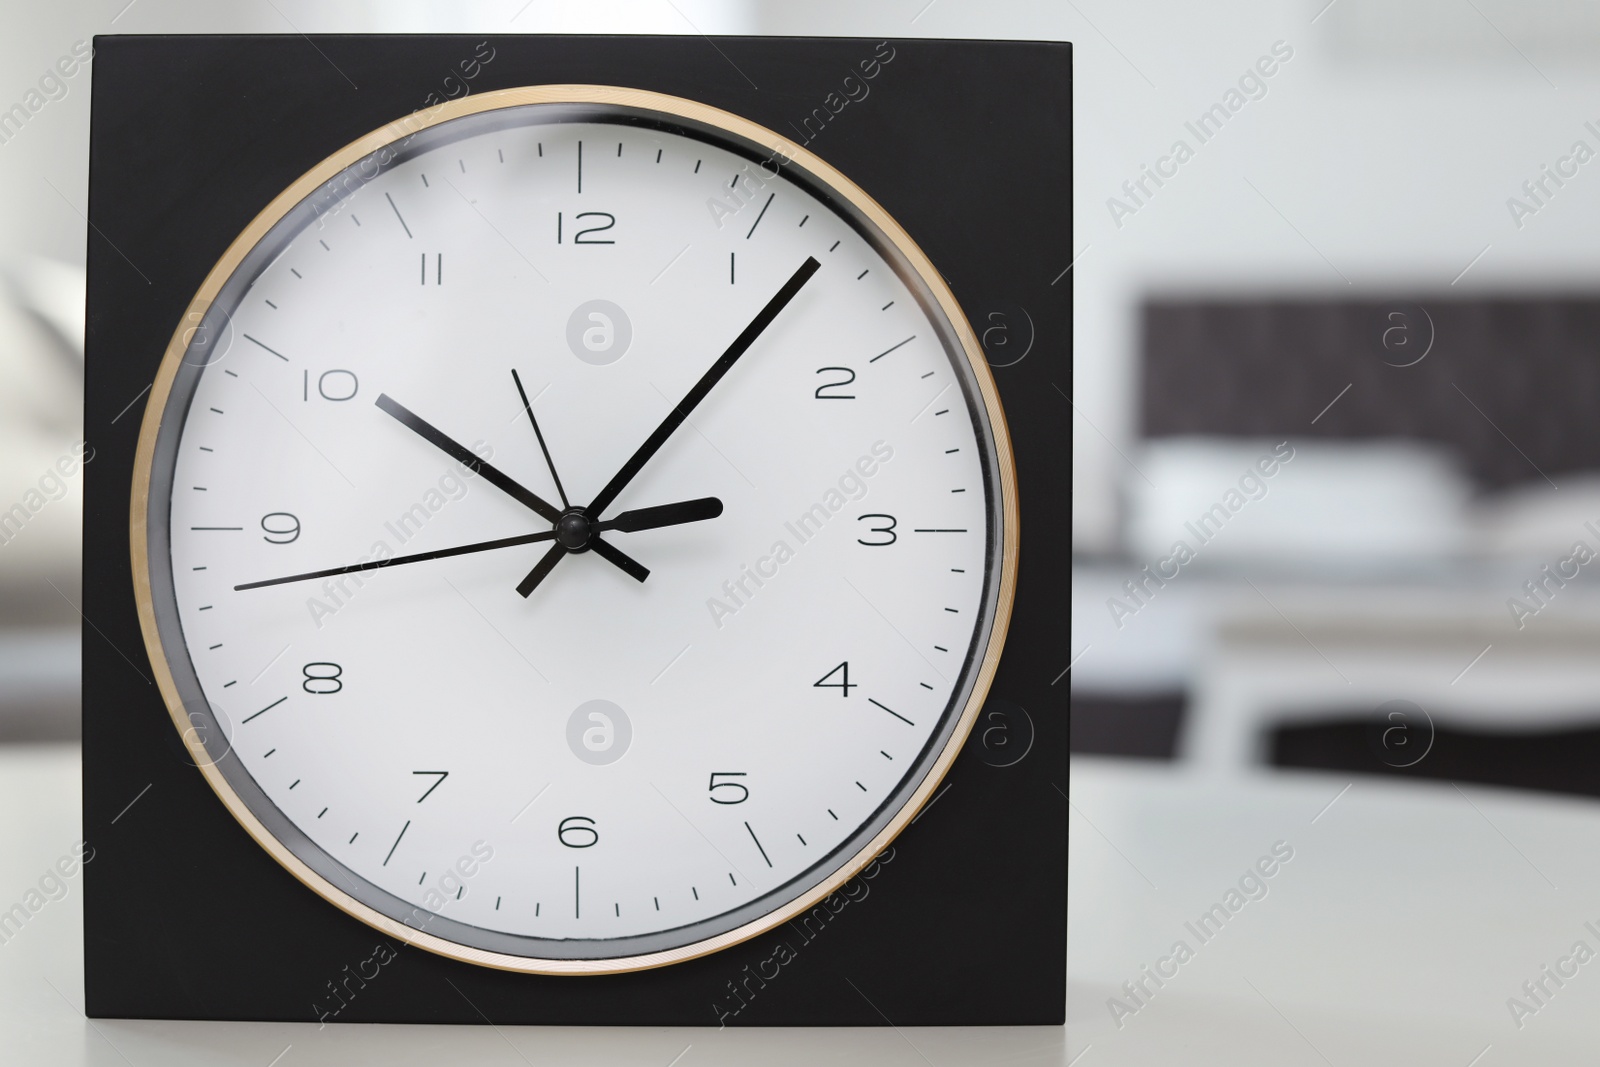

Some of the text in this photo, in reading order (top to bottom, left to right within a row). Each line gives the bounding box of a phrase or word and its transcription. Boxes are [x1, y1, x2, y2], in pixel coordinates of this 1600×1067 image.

[557, 211, 616, 245] 12
[421, 252, 442, 286] 11
[730, 251, 735, 285] 1
[303, 369, 359, 402] 10
[814, 366, 857, 400] 2
[260, 511, 301, 545] 9
[856, 513, 898, 547] 3
[302, 661, 343, 695] 8
[812, 660, 858, 698] 4
[412, 770, 450, 804] 7
[708, 771, 750, 806] 5
[557, 815, 599, 849] 6
